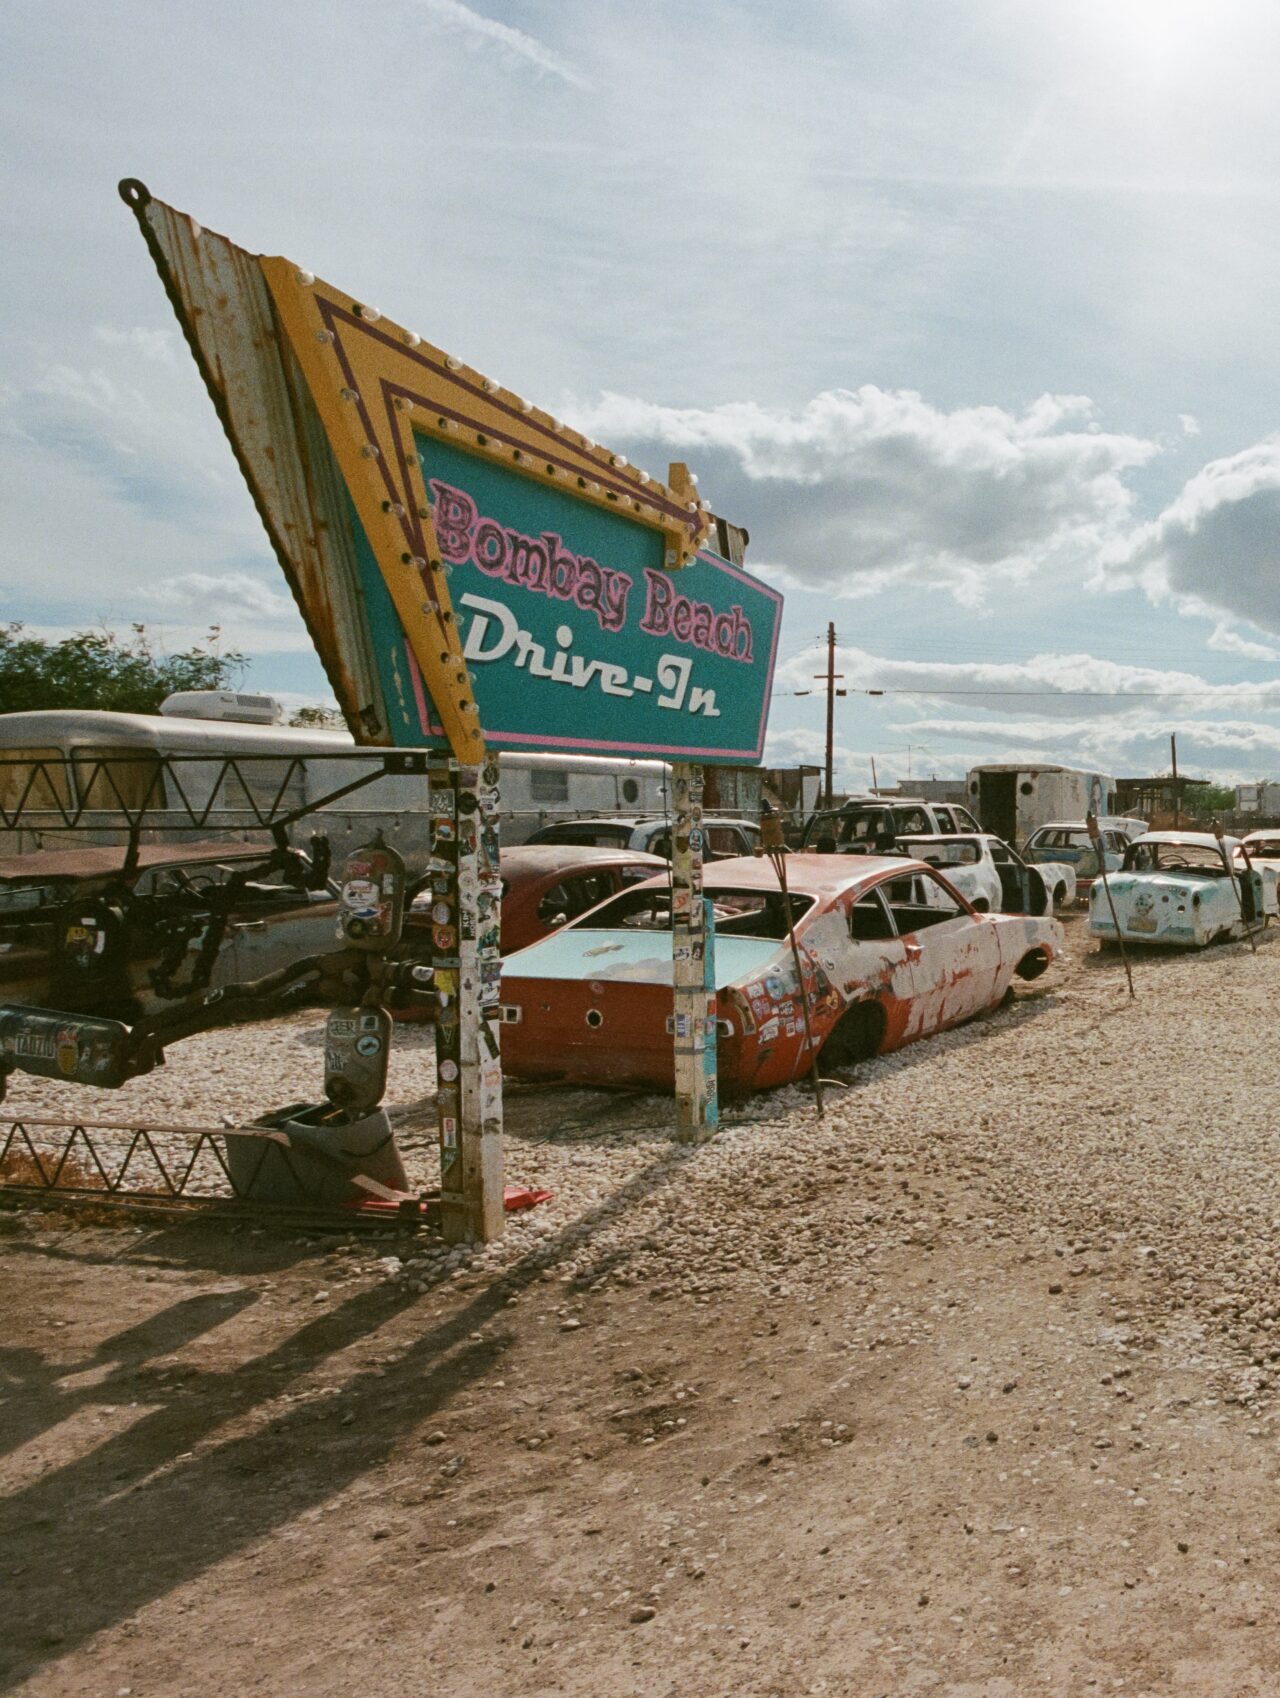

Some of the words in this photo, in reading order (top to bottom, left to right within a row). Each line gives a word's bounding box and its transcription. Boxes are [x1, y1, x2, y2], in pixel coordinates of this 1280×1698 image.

[430, 479, 633, 632] Bombay
[640, 567, 753, 663] Beach
[460, 592, 720, 717] Drive-In
